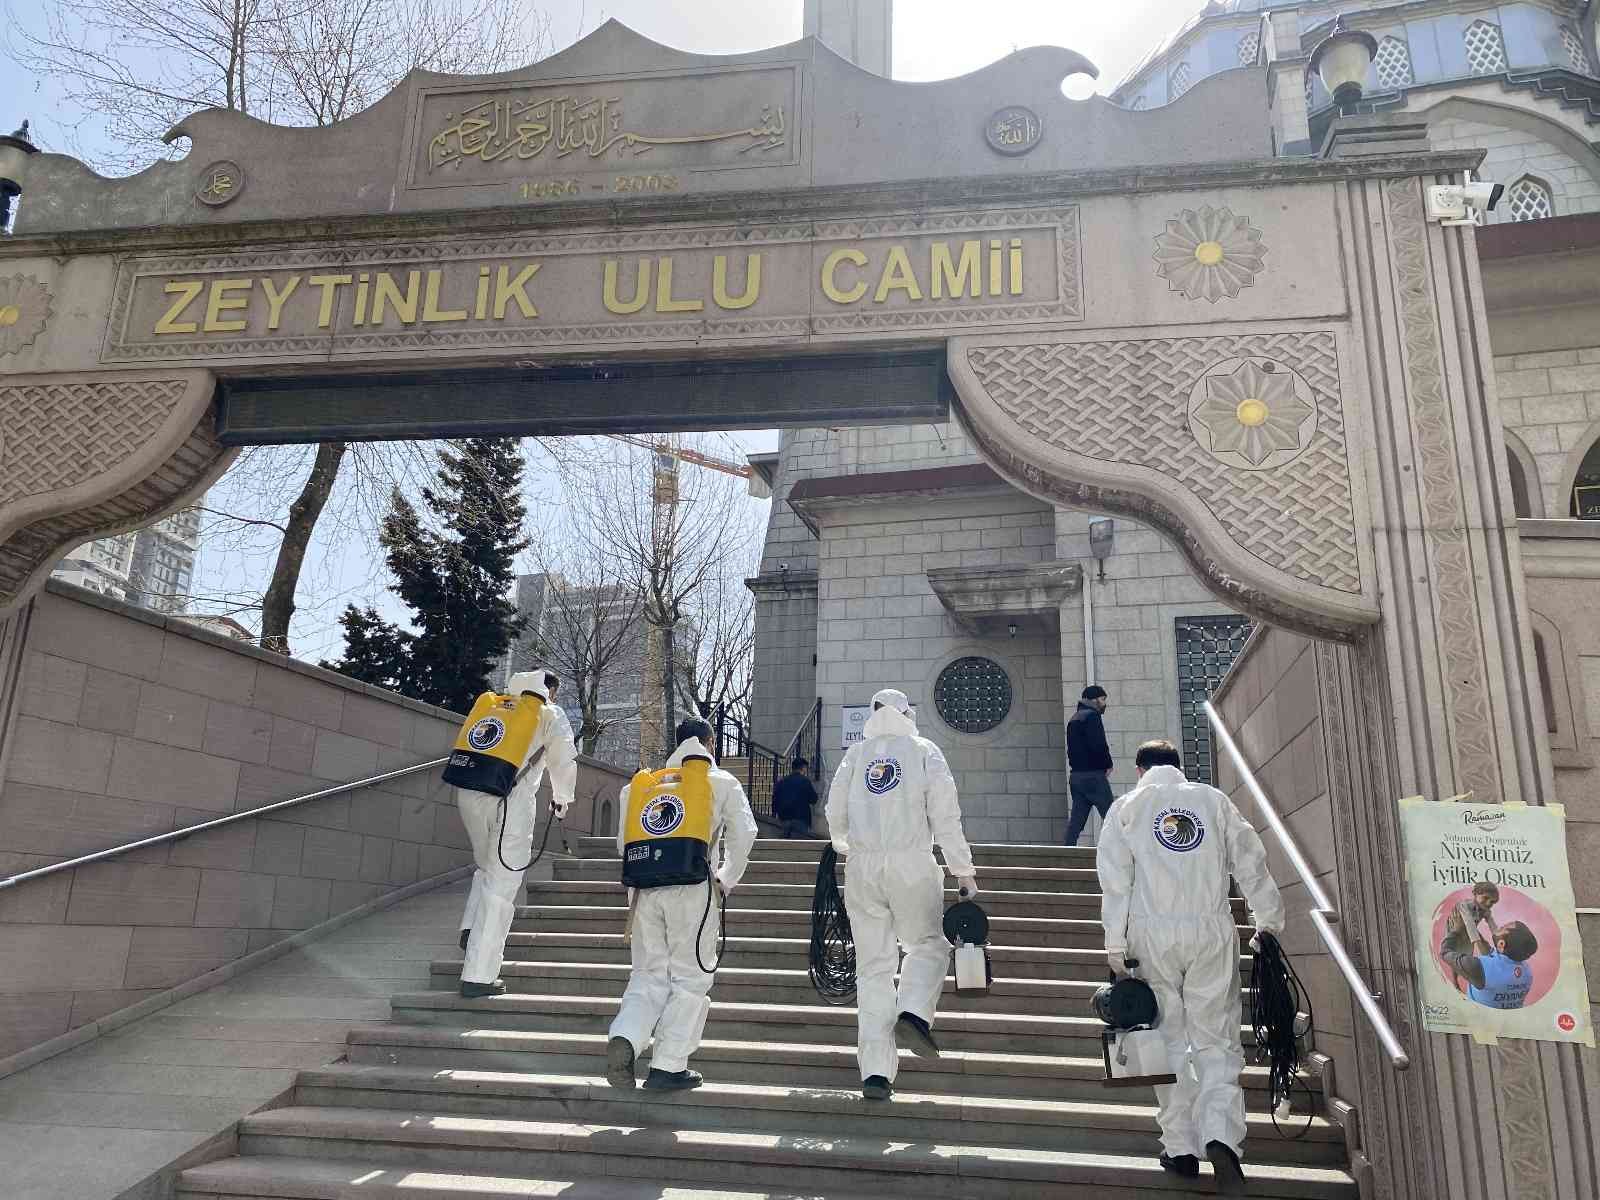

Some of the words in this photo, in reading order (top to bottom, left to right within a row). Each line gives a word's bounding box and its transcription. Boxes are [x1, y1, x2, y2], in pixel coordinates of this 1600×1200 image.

[602, 253, 762, 314] ULU
[1432, 860, 1478, 886] İyilik
[1484, 867, 1546, 889] Olsun
